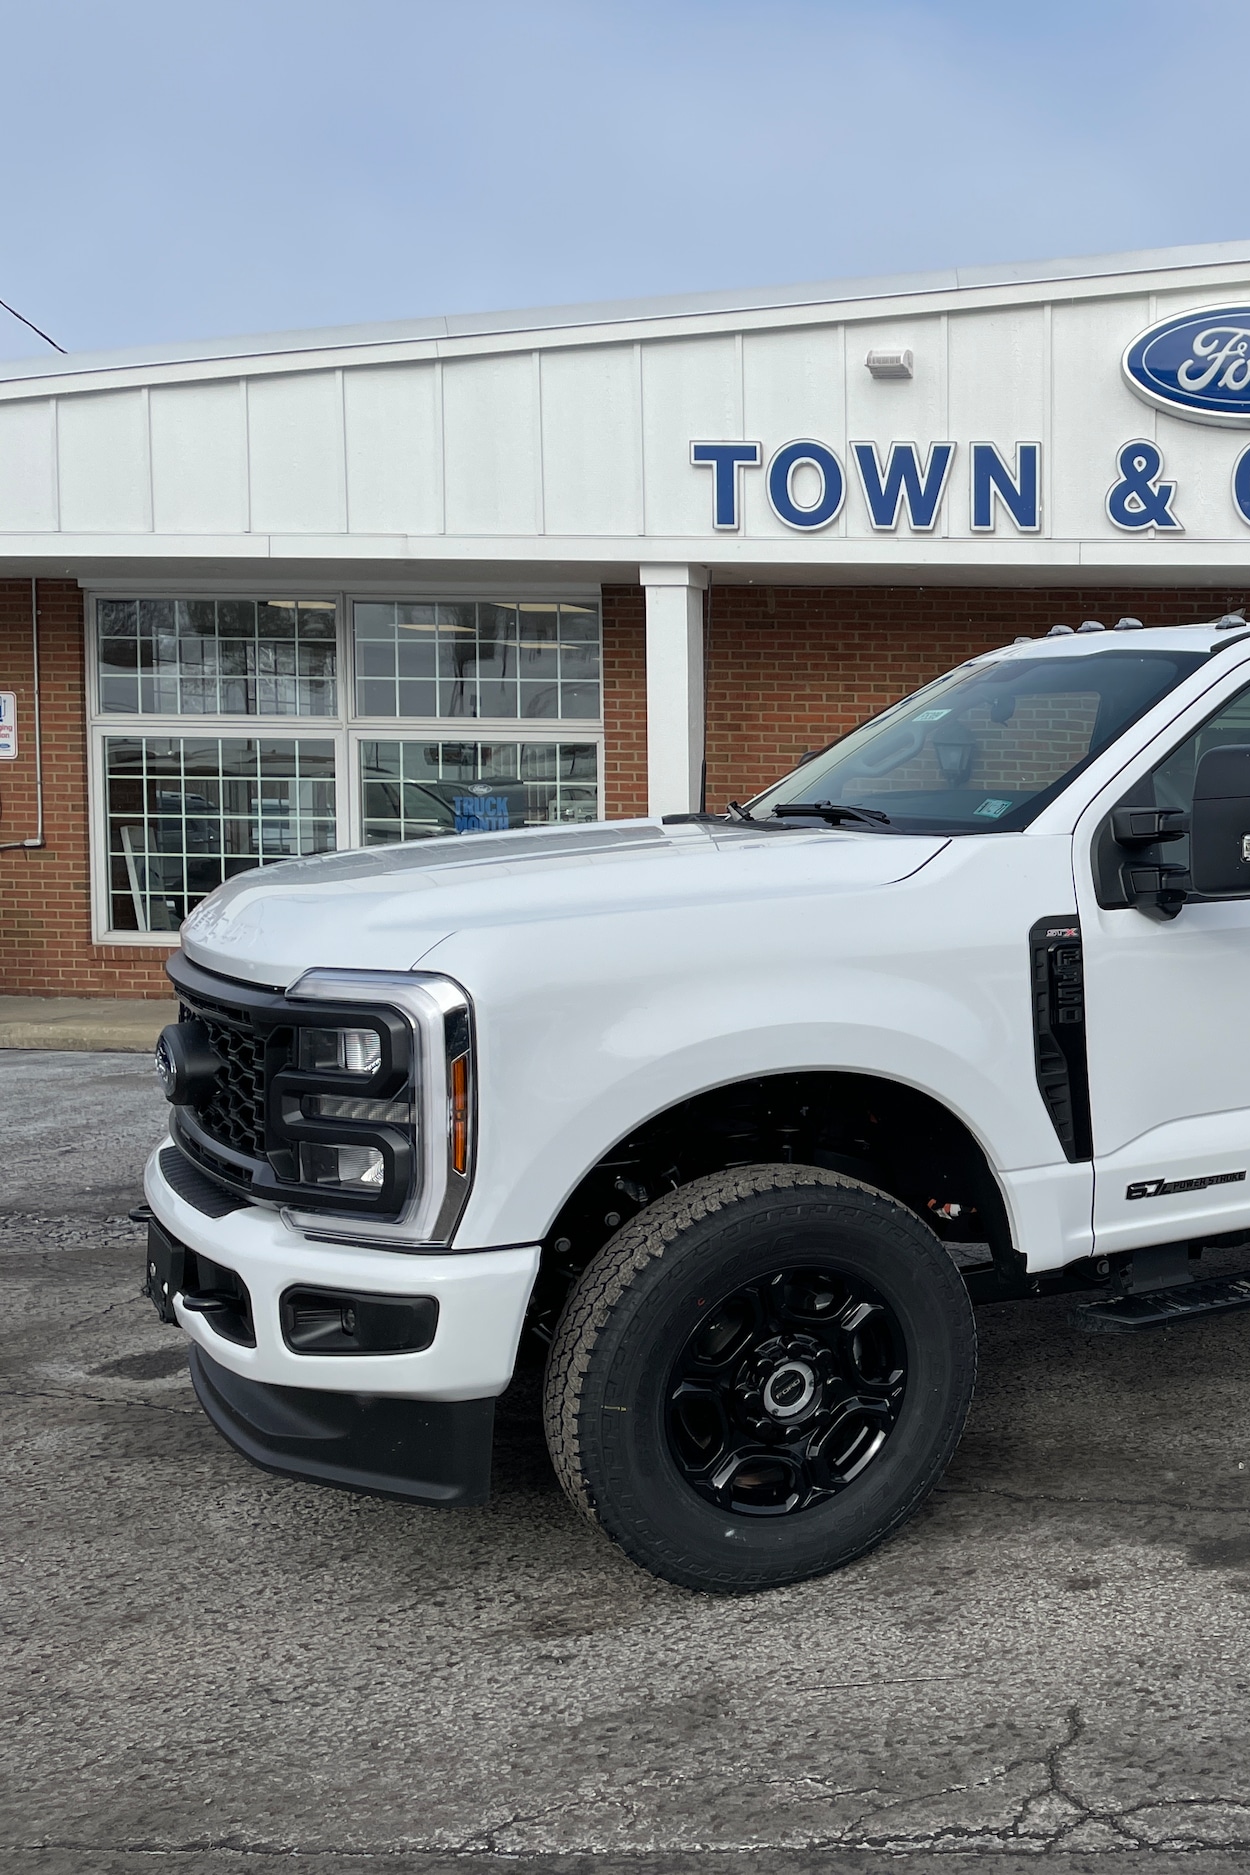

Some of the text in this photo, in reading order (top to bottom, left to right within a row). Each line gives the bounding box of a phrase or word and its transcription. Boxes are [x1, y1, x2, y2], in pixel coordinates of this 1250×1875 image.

[690, 440, 1042, 532] TOWN
[1106, 438, 1185, 531] &
[453, 796, 509, 817] TRUCK
[454, 816, 509, 834] MONTH
[1173, 1179, 1207, 1190] POWER
[1207, 1172, 1246, 1185] STROKE
[776, 1379, 800, 1400] FORD
